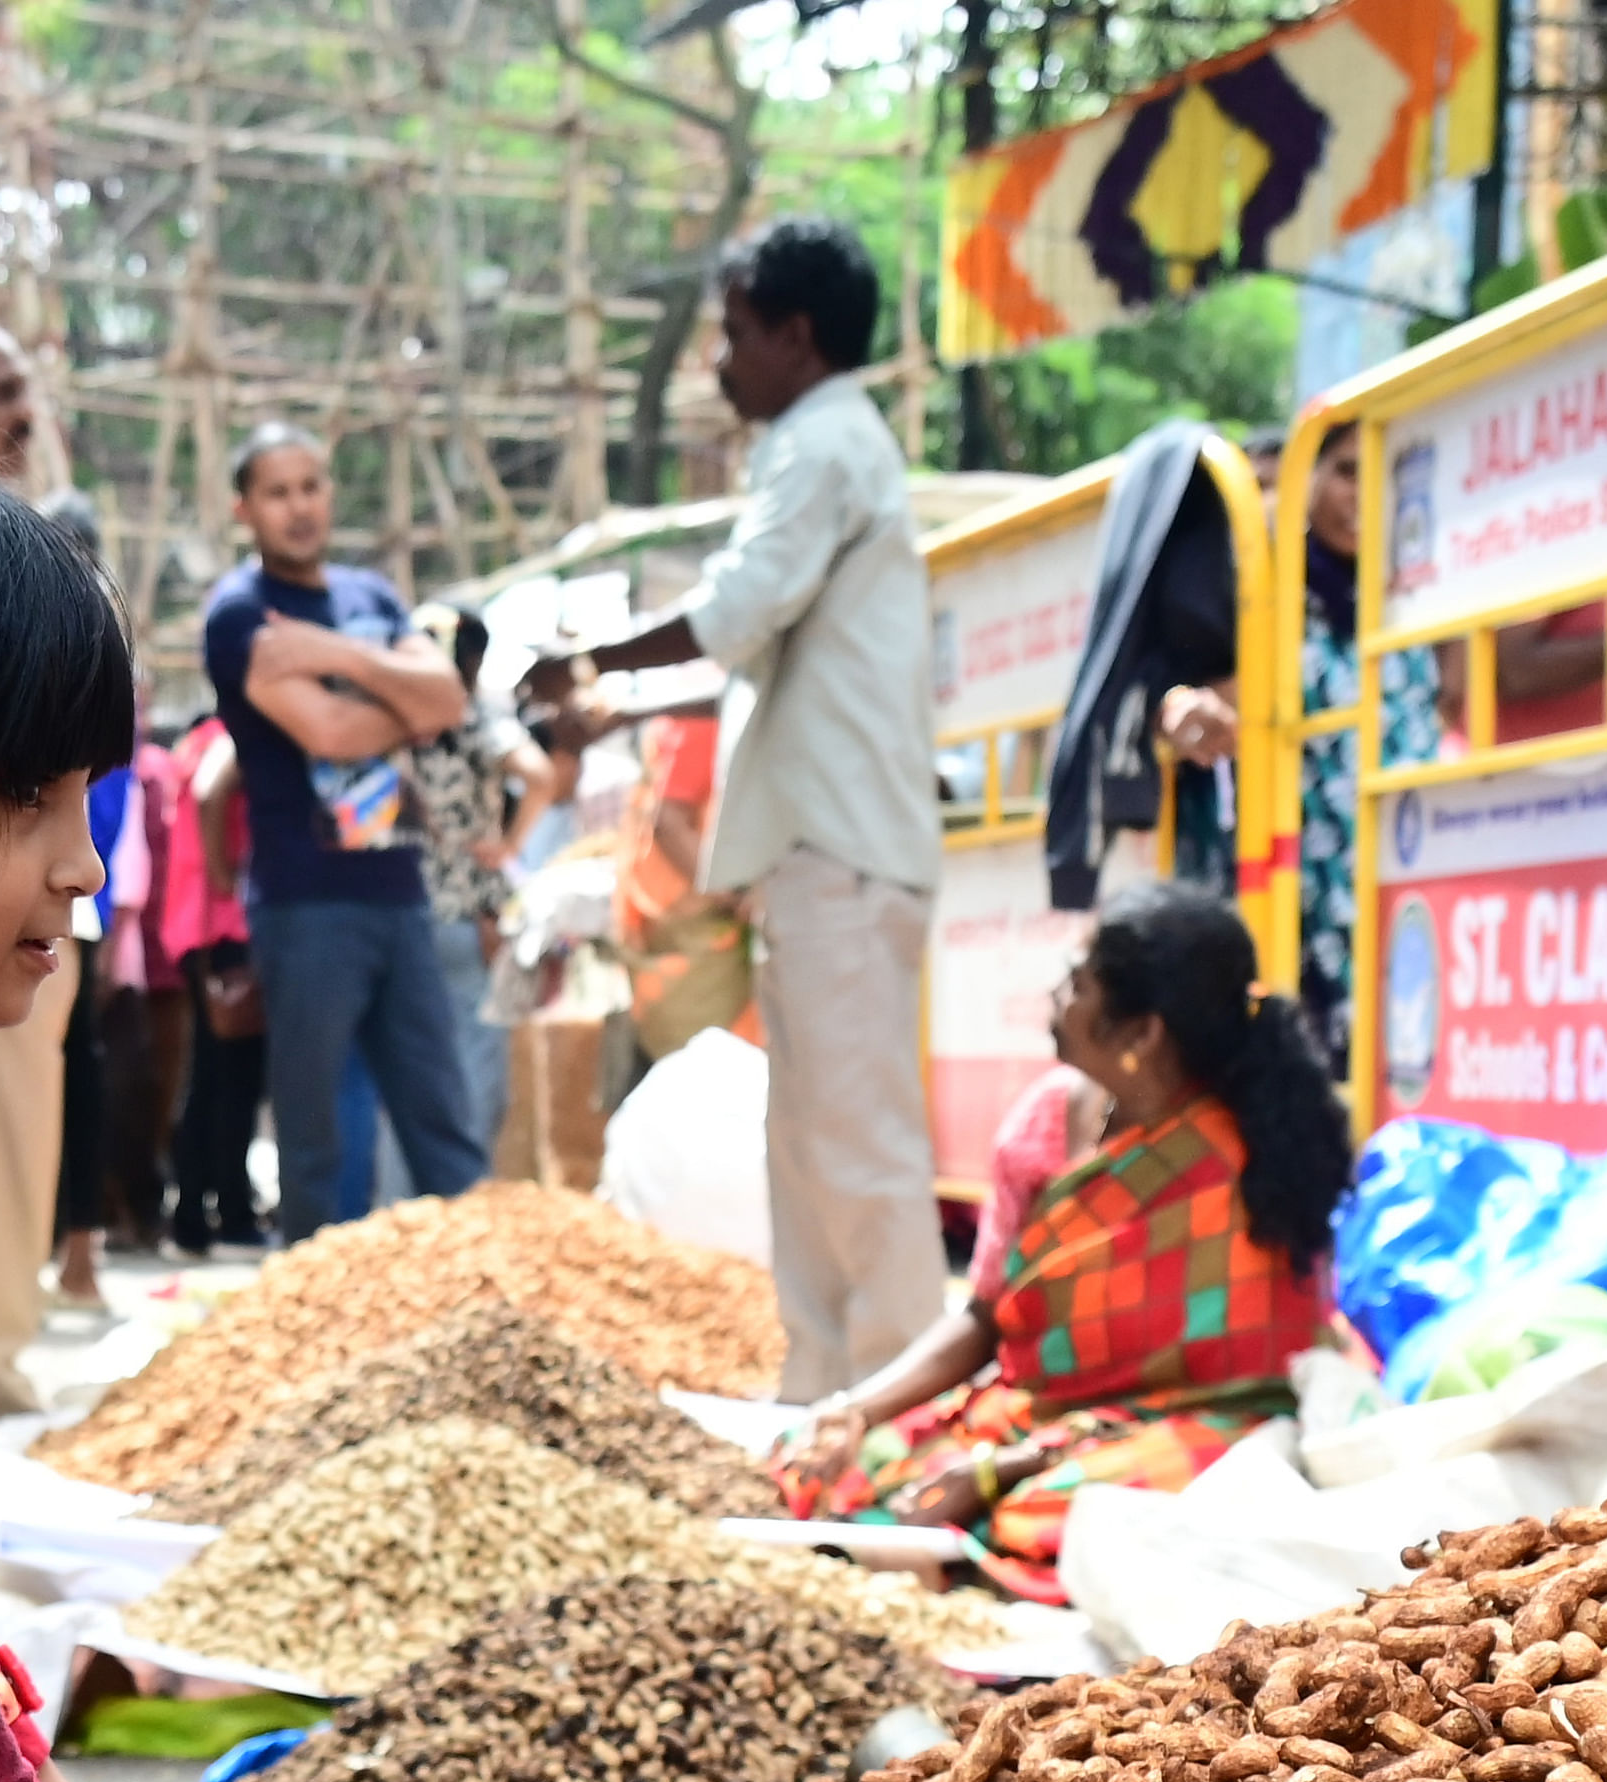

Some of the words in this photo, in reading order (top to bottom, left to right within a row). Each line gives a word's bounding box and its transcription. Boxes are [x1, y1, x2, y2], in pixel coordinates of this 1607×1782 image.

[1450, 515, 1518, 572] Traffic
[1524, 499, 1592, 546] Police
[1449, 894, 1512, 1010] ST.
[1449, 1025, 1549, 1101] Schools
[1554, 1022, 1577, 1104] &
